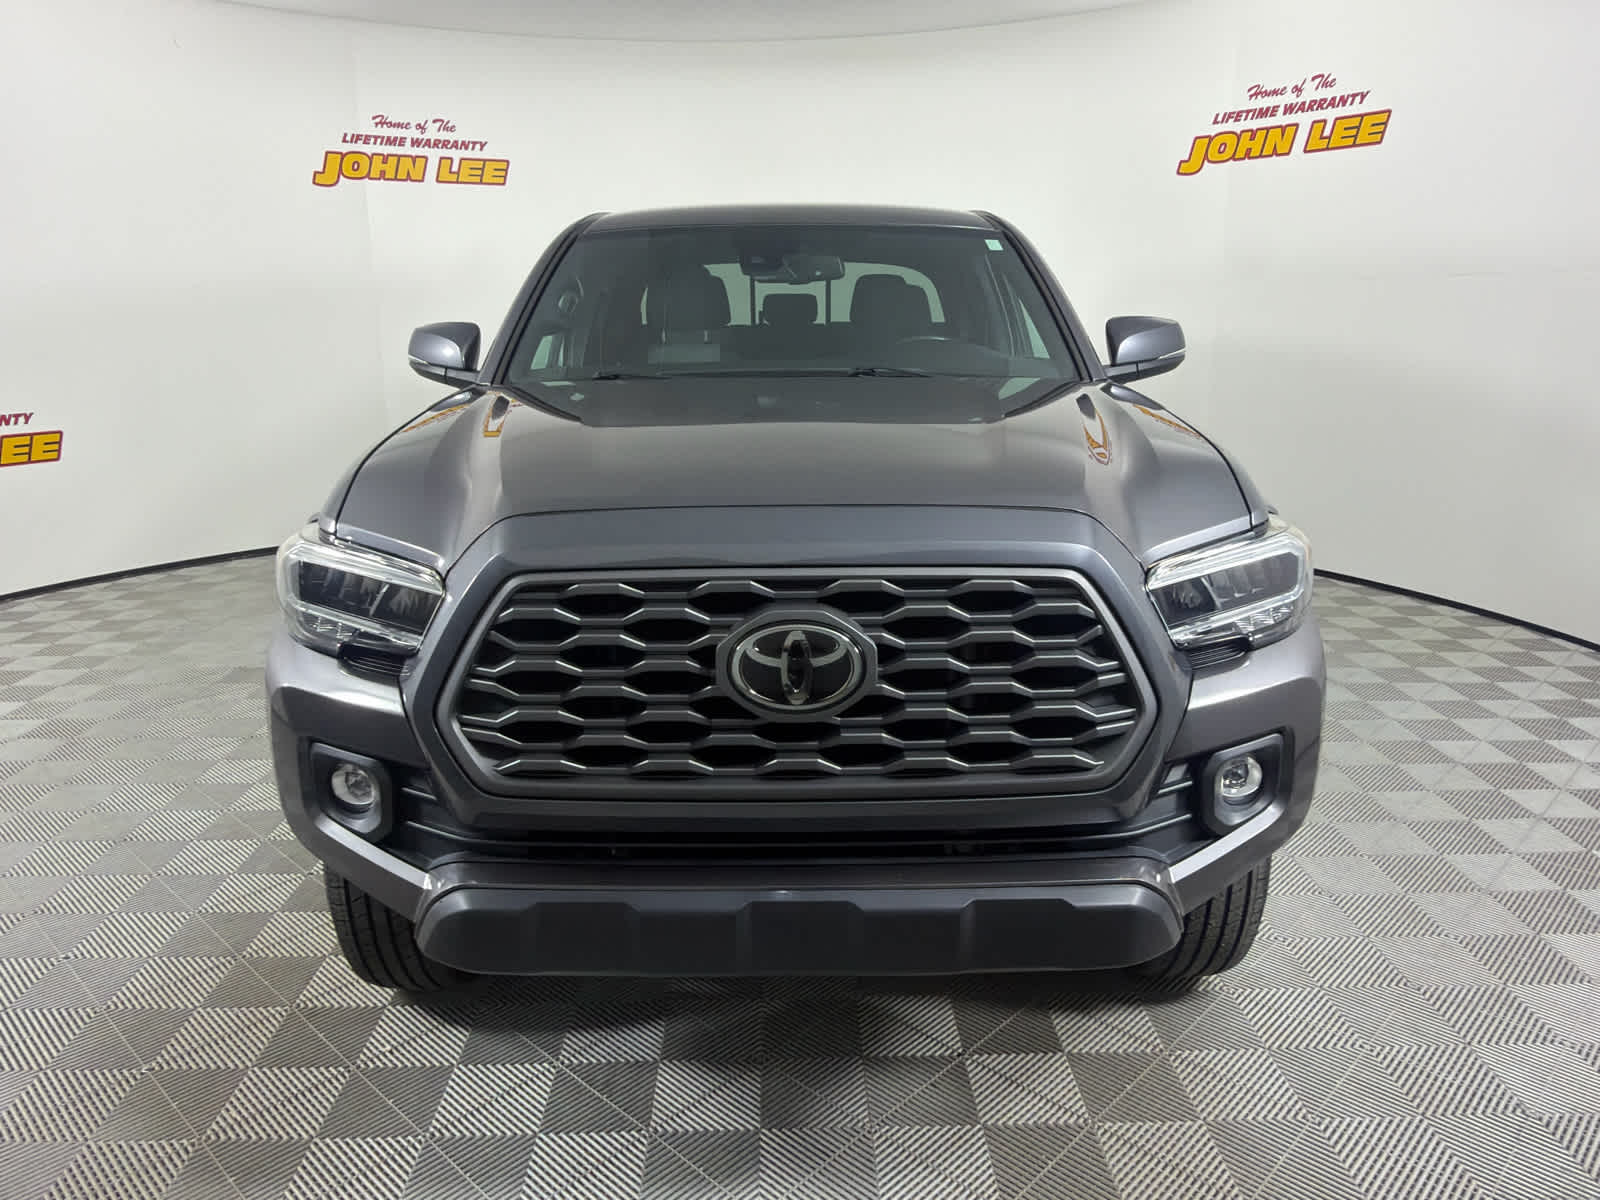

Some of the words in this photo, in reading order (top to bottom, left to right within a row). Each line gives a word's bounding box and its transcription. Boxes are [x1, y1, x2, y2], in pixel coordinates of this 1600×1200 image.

[1247, 84, 1287, 100] Home
[1291, 78, 1306, 98] of
[1311, 73, 1336, 91] The
[1212, 105, 1280, 125] LIFETIME
[1282, 90, 1371, 116] WARRANTY
[371, 114, 411, 129] Home
[415, 120, 428, 134] of
[432, 118, 456, 133] The
[341, 133, 407, 147] LIFETIME
[410, 137, 487, 151] WARRANTY
[1176, 123, 1299, 175] JOHN
[1303, 108, 1392, 153] LEE
[312, 151, 428, 187] JOHN
[436, 156, 510, 186] LEE
